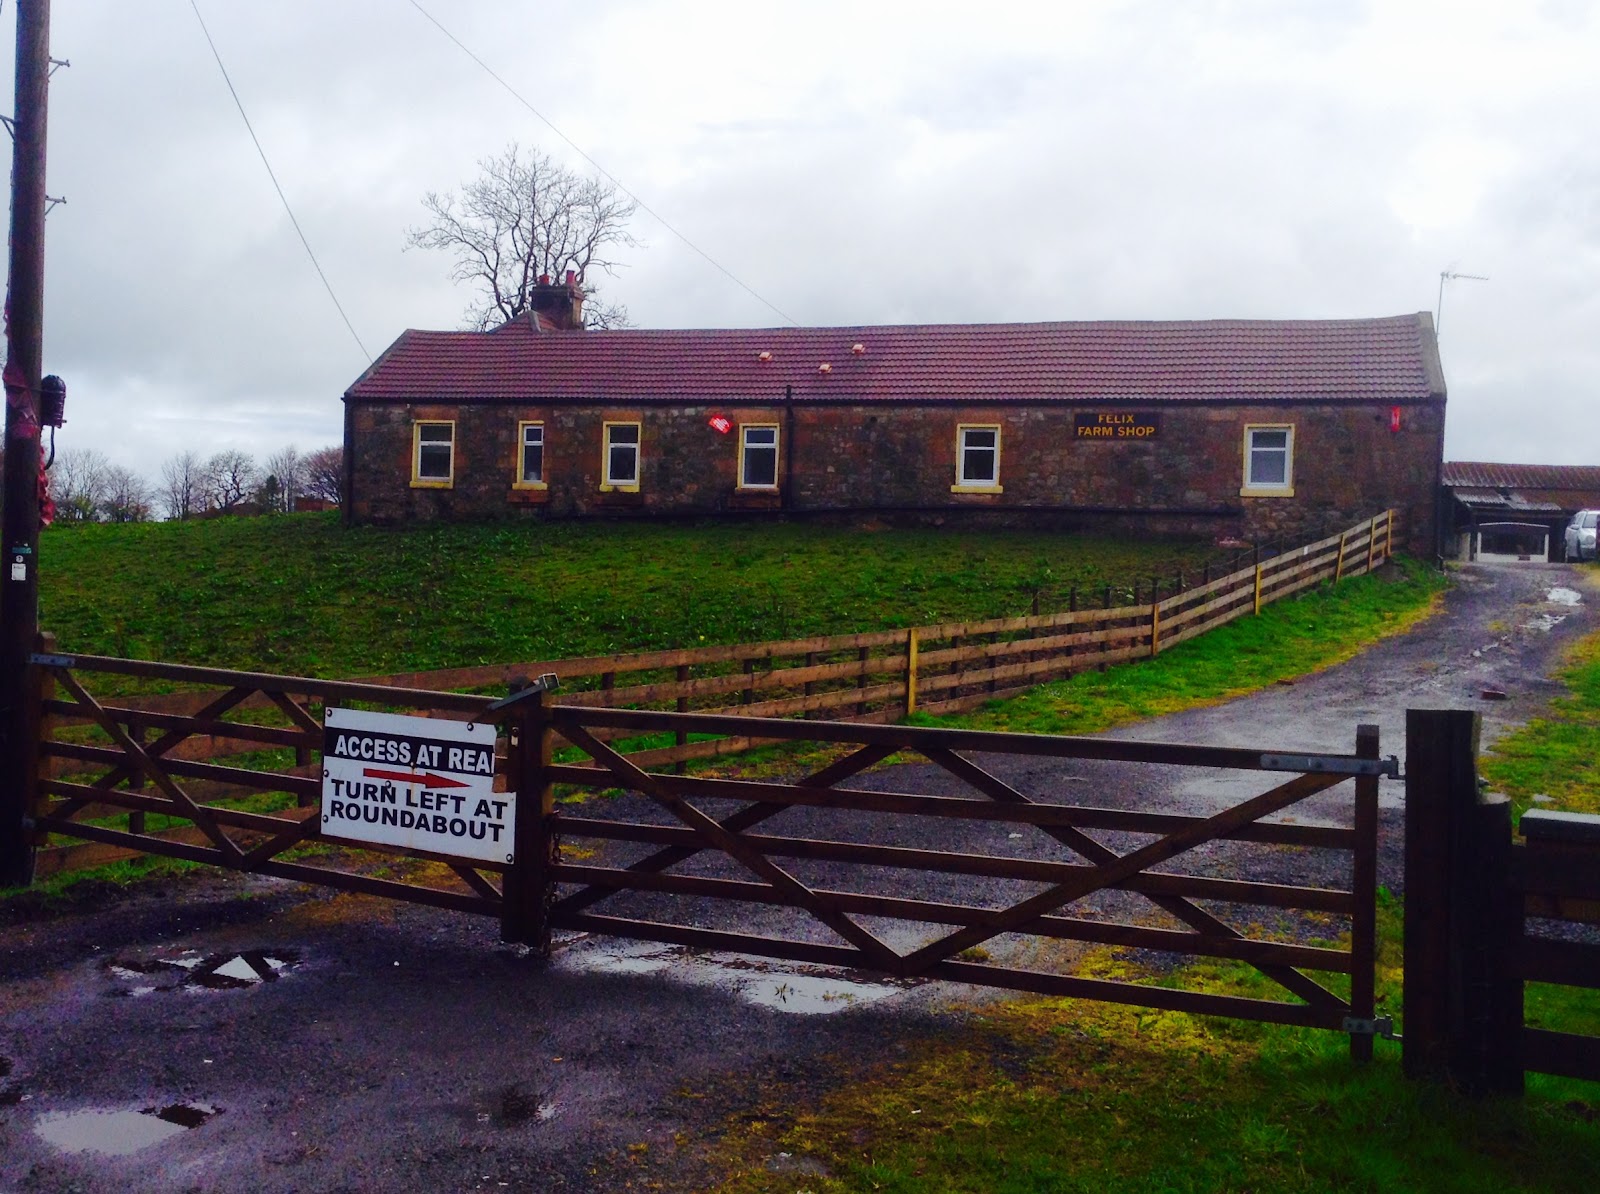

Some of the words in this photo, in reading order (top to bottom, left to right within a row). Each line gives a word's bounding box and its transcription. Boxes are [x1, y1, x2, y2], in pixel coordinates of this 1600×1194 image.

[1077, 426, 1113, 436] FARM
[1117, 426, 1155, 437] SHOP
[1098, 414, 1134, 424] FELIX
[334, 734, 411, 764] ACCESS
[416, 744, 442, 768] AT
[448, 747, 495, 774] REA
[331, 778, 396, 805] TURN
[405, 788, 466, 814] LEFT
[473, 799, 508, 820] AT
[330, 800, 505, 842] ROUNDABOUT
